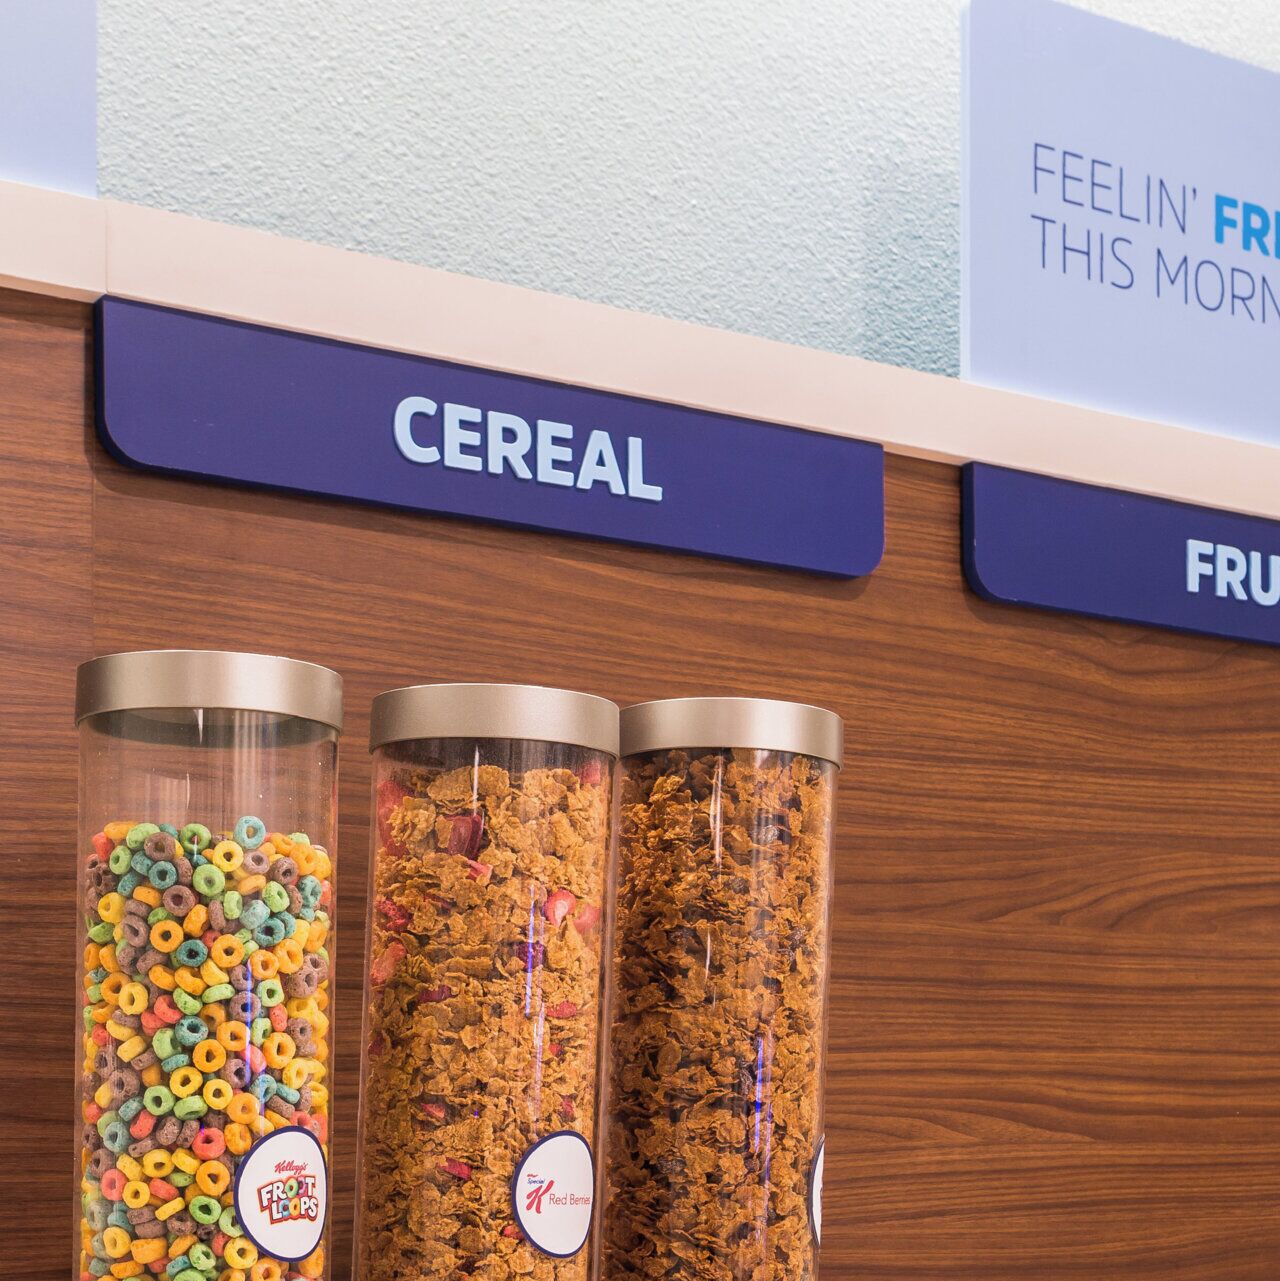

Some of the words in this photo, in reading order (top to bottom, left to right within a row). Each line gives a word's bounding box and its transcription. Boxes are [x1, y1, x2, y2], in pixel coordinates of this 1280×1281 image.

[1033, 142, 1198, 235] FEELIN'
[1031, 213, 1135, 291] THIS
[392, 395, 663, 503] CEREAL
[274, 1160, 308, 1175] Kellogg's
[260, 1176, 317, 1208] FROOT
[271, 1196, 319, 1221] LOOPS
[526, 1180, 555, 1214] K
[549, 1193, 567, 1205] Red
[569, 1193, 591, 1206] Berries
